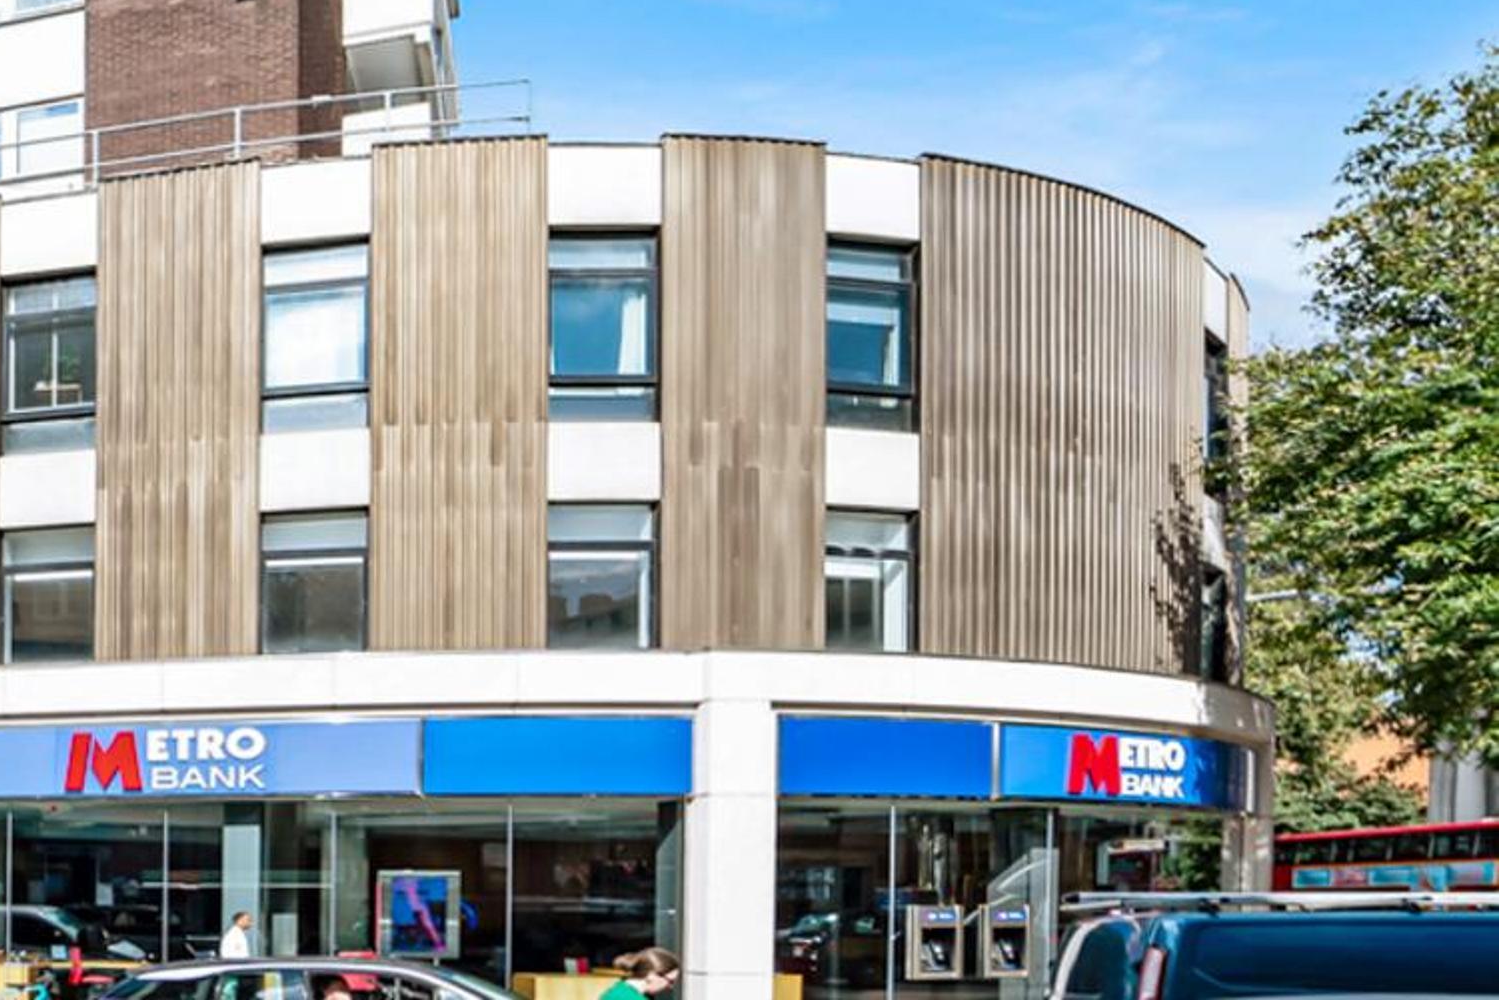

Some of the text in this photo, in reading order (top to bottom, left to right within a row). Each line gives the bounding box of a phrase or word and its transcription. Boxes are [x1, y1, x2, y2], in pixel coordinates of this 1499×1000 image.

[65, 728, 266, 791] METRO
[150, 764, 265, 789] BANK
[1067, 733, 1185, 796] METRO
[1121, 772, 1185, 798] BANK
